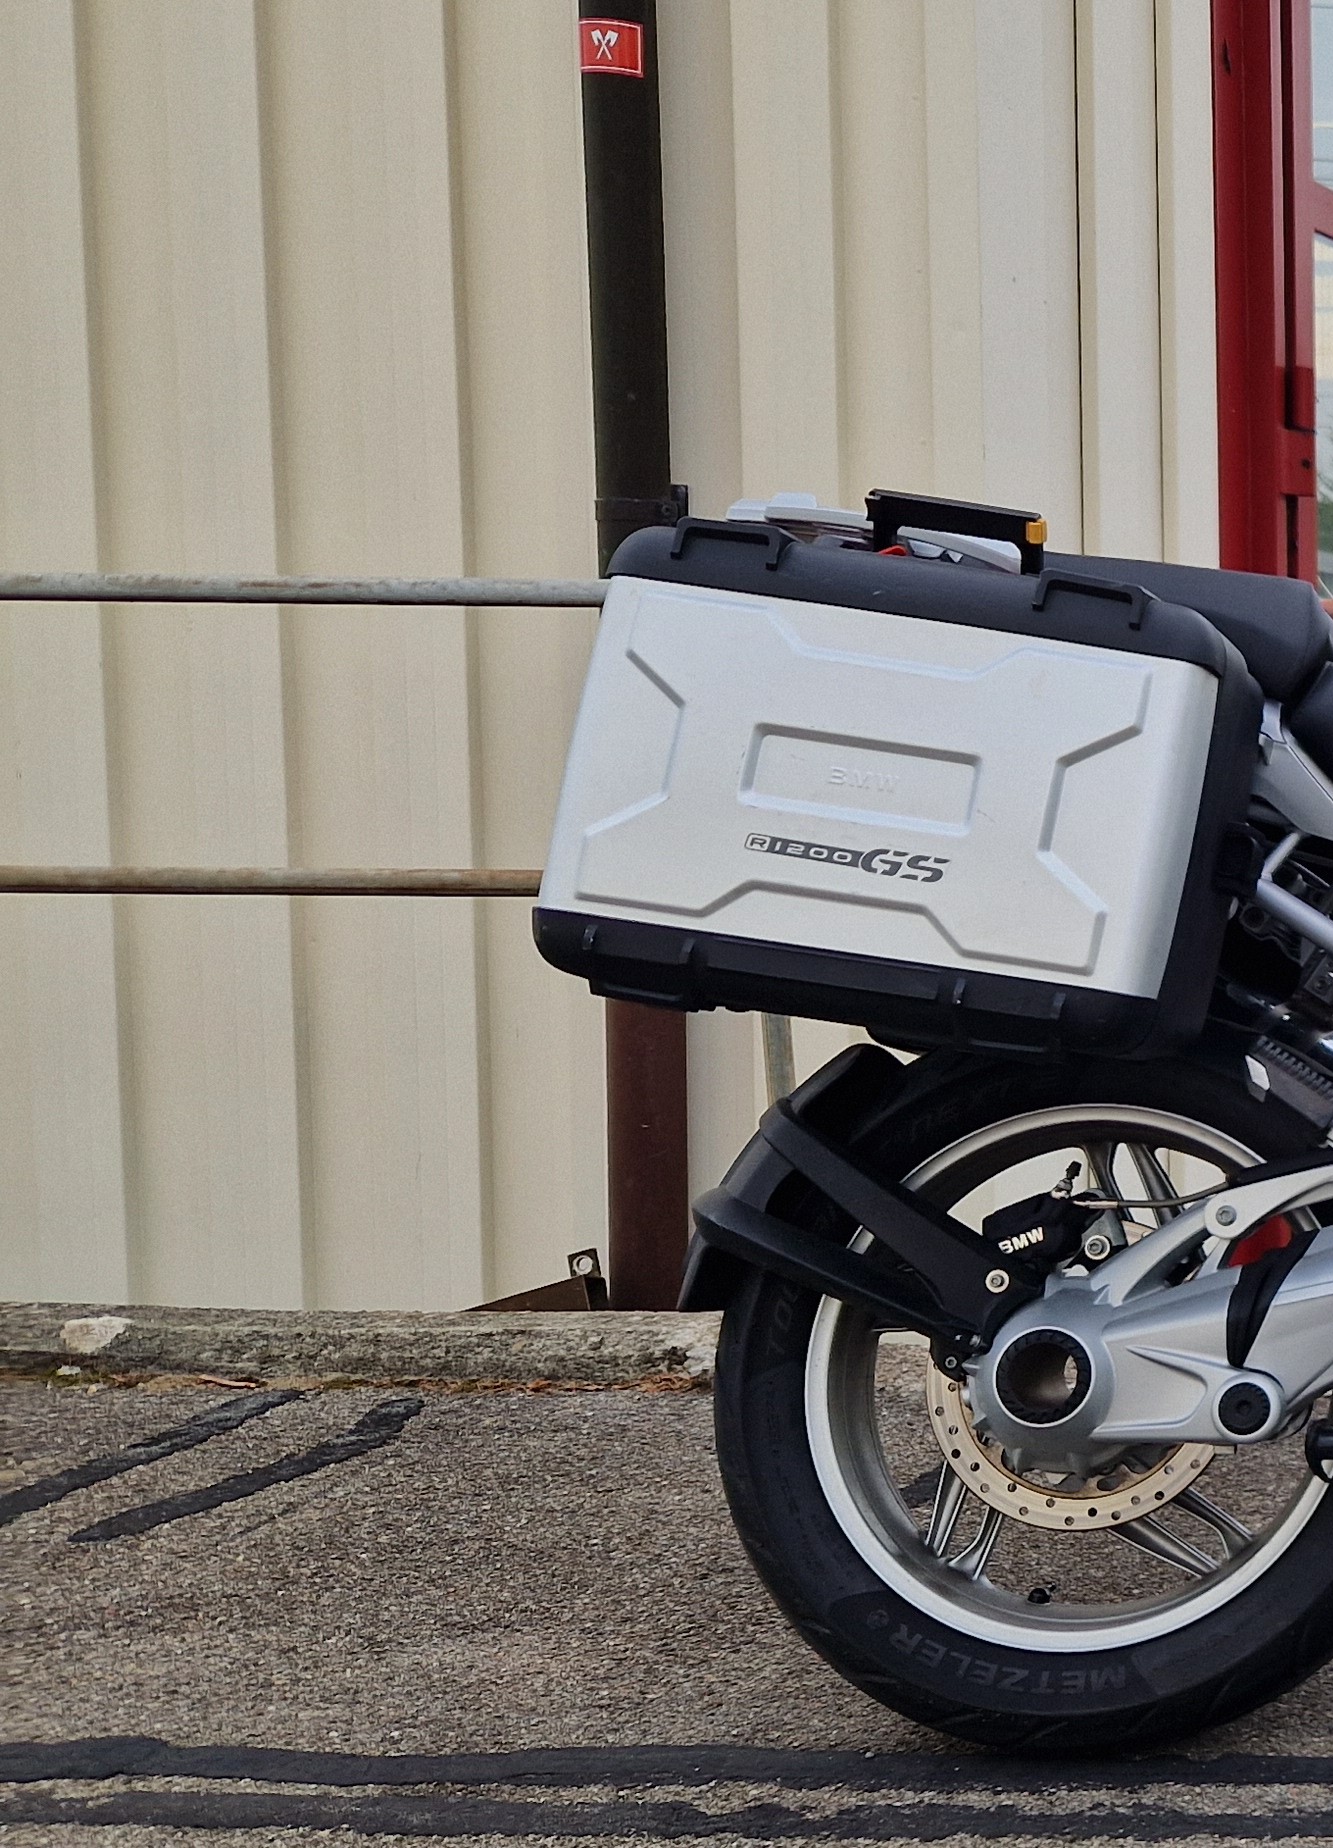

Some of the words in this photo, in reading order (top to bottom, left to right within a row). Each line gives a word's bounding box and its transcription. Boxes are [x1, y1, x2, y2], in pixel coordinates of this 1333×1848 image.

[827, 766, 900, 793] BMW
[997, 1226, 1044, 1255] BMW
[889, 1622, 1127, 1694] METZELER
